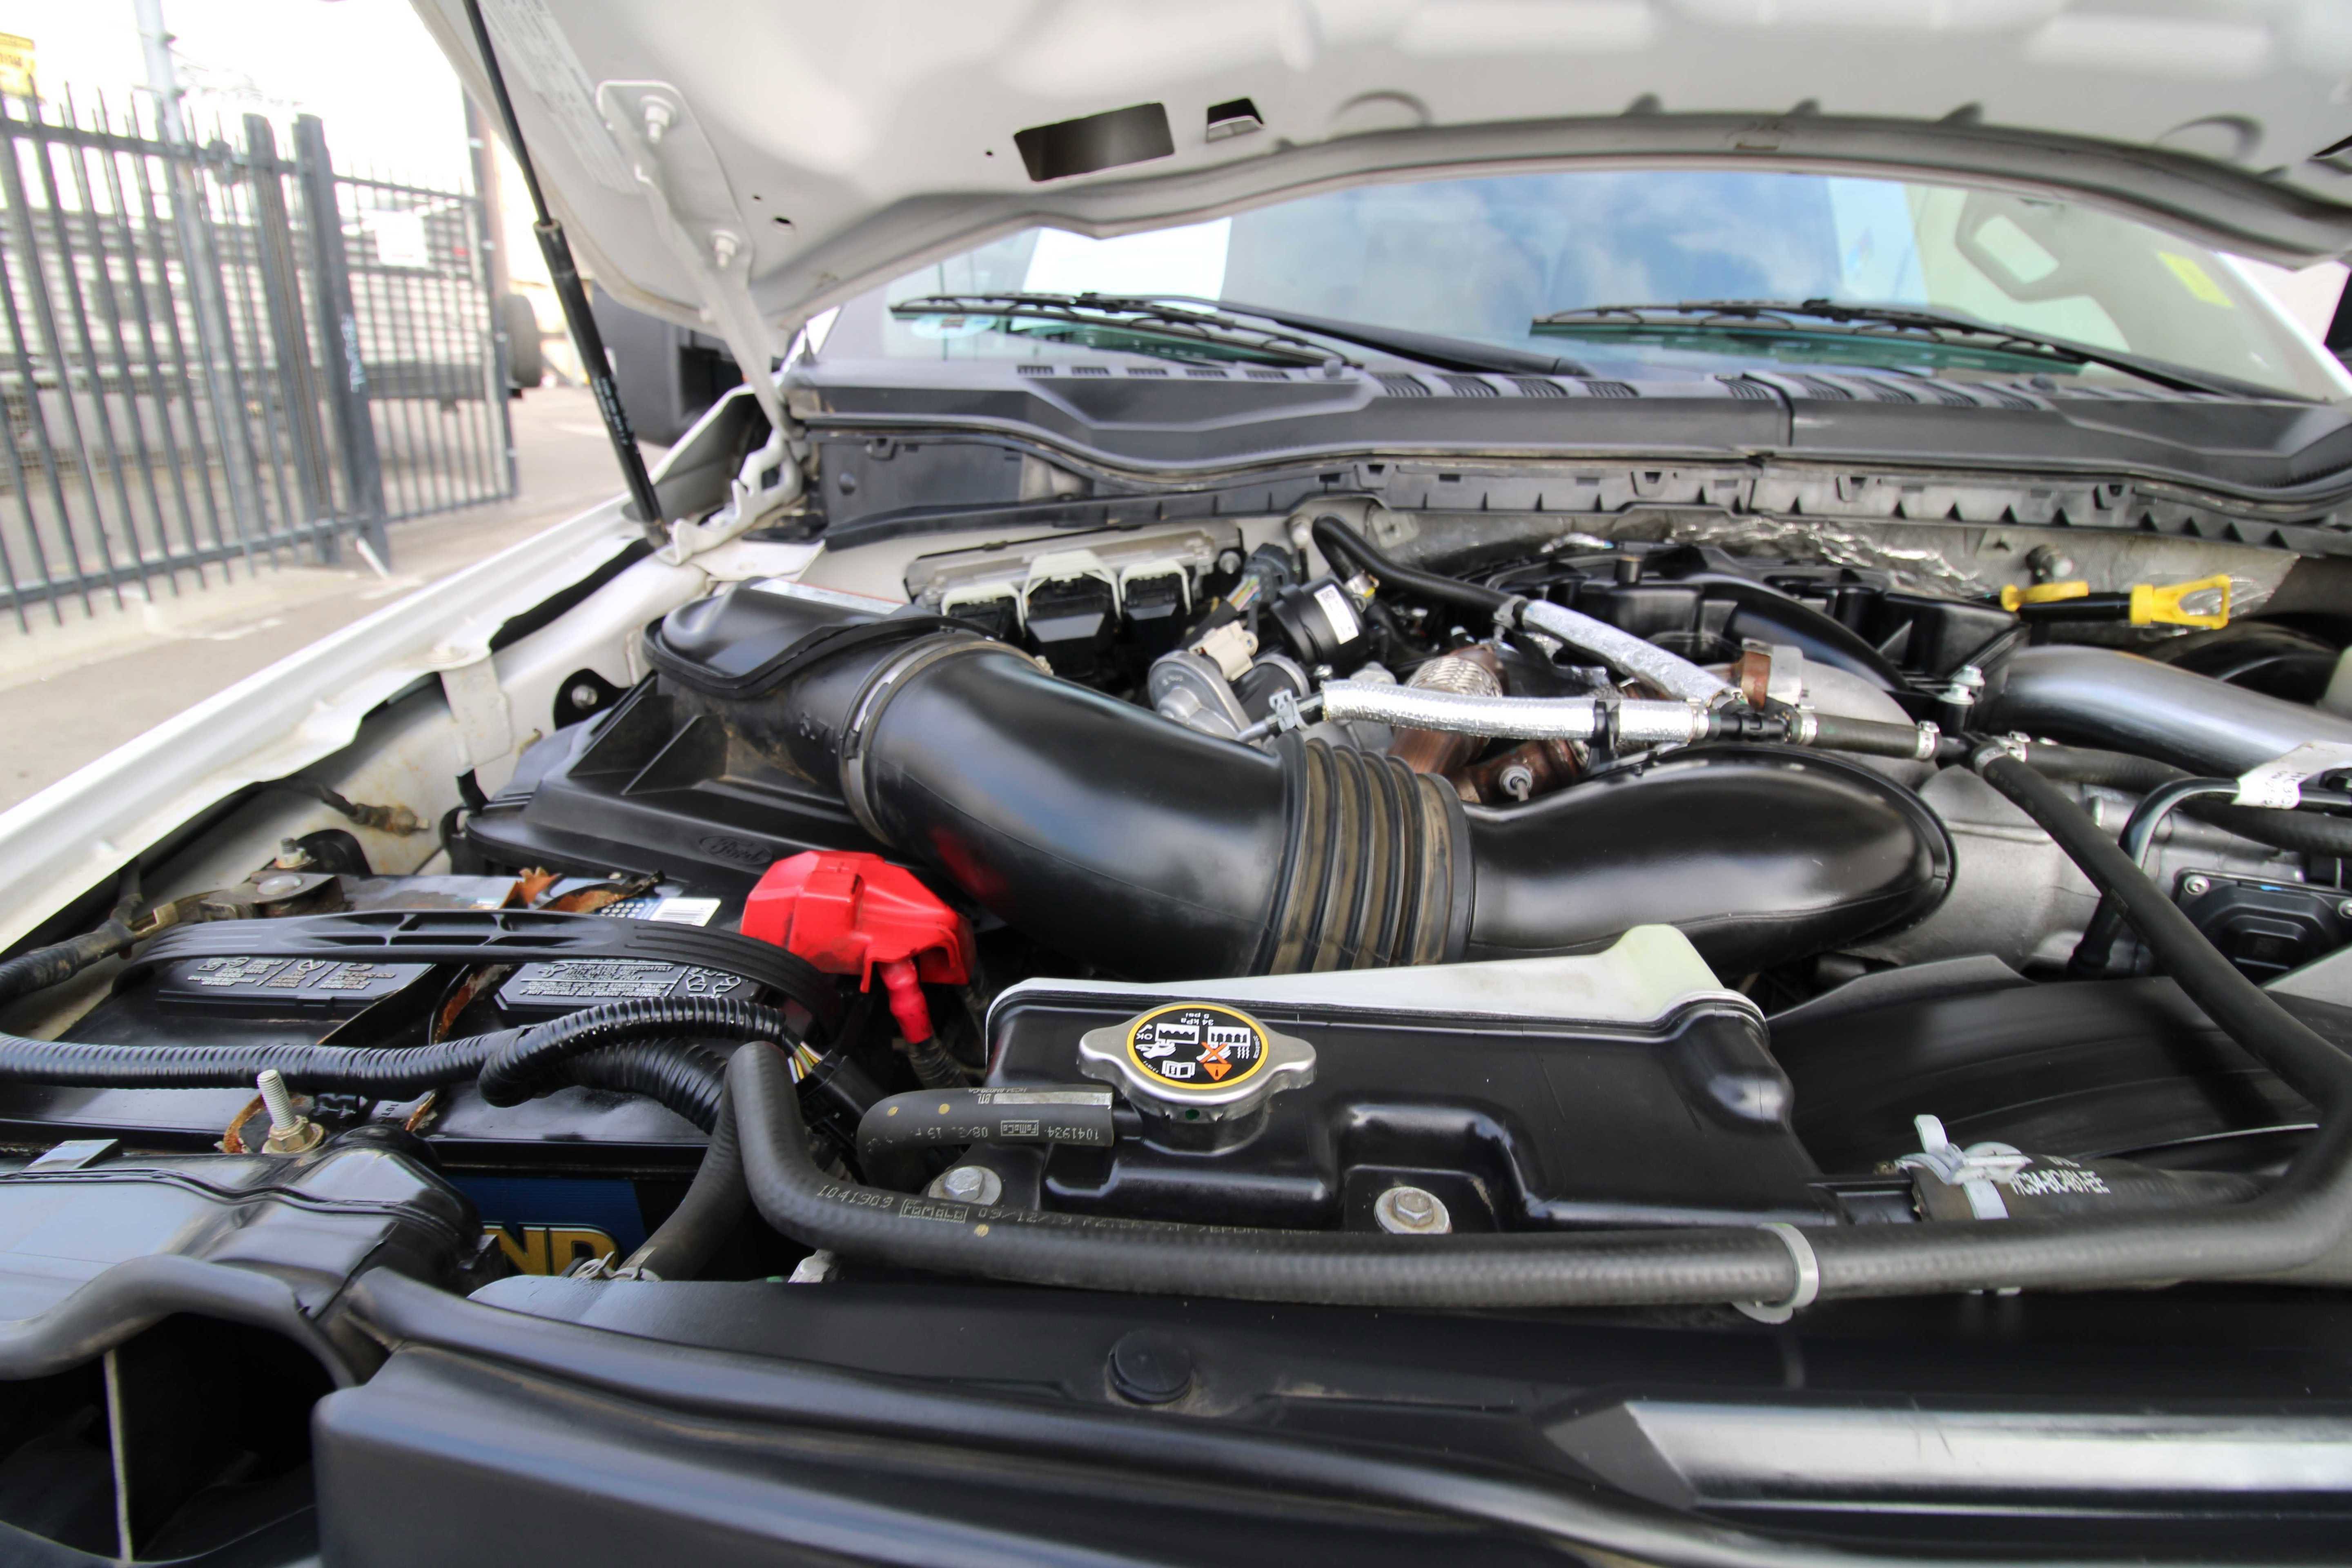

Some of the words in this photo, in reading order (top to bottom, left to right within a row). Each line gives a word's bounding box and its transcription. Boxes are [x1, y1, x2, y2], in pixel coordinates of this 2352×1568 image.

[706, 837, 766, 863] Ford
[978, 1093, 991, 1105] BTL
[1002, 1122, 1038, 1135] FoMoCo
